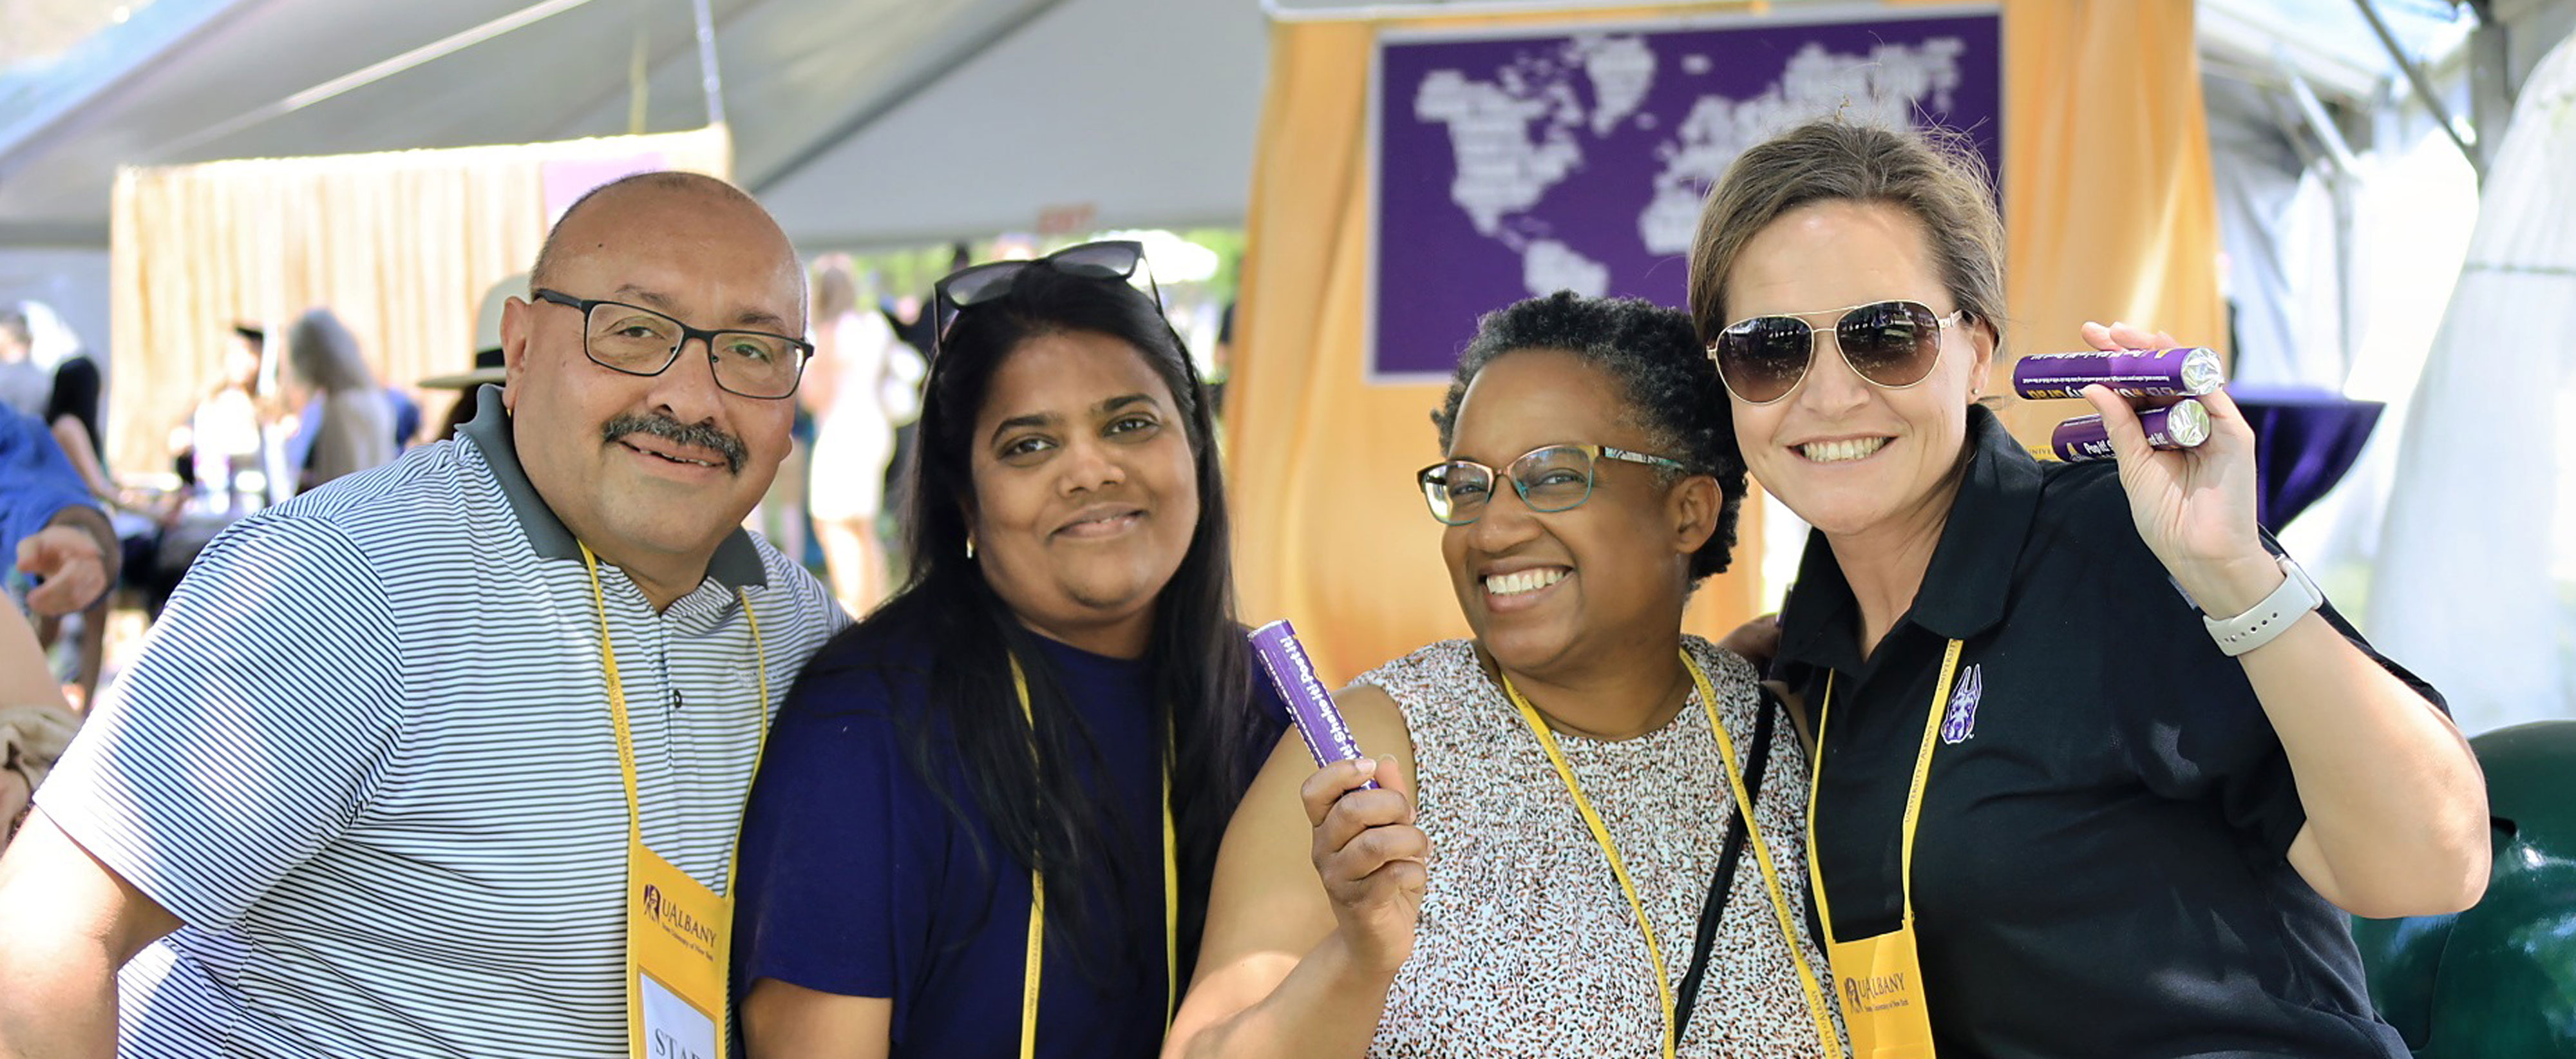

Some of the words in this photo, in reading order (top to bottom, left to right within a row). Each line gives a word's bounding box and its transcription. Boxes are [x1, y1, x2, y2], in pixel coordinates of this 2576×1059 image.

[1280, 636, 1296, 653] it!
[1290, 651, 1313, 683] Post
[1937, 640, 1956, 691] UNIVERSIT
[1307, 684, 1323, 701] it!
[607, 672, 625, 728] UNIVERSITY
[620, 734, 633, 769] ALBANY
[1319, 700, 1347, 743] Shake
[1904, 767, 1922, 823] UNIVERSITY
[1919, 723, 1934, 759] ALBANY
[1811, 989, 1827, 1022] ALBANY
[1821, 1029, 1839, 1058] ERSITY
